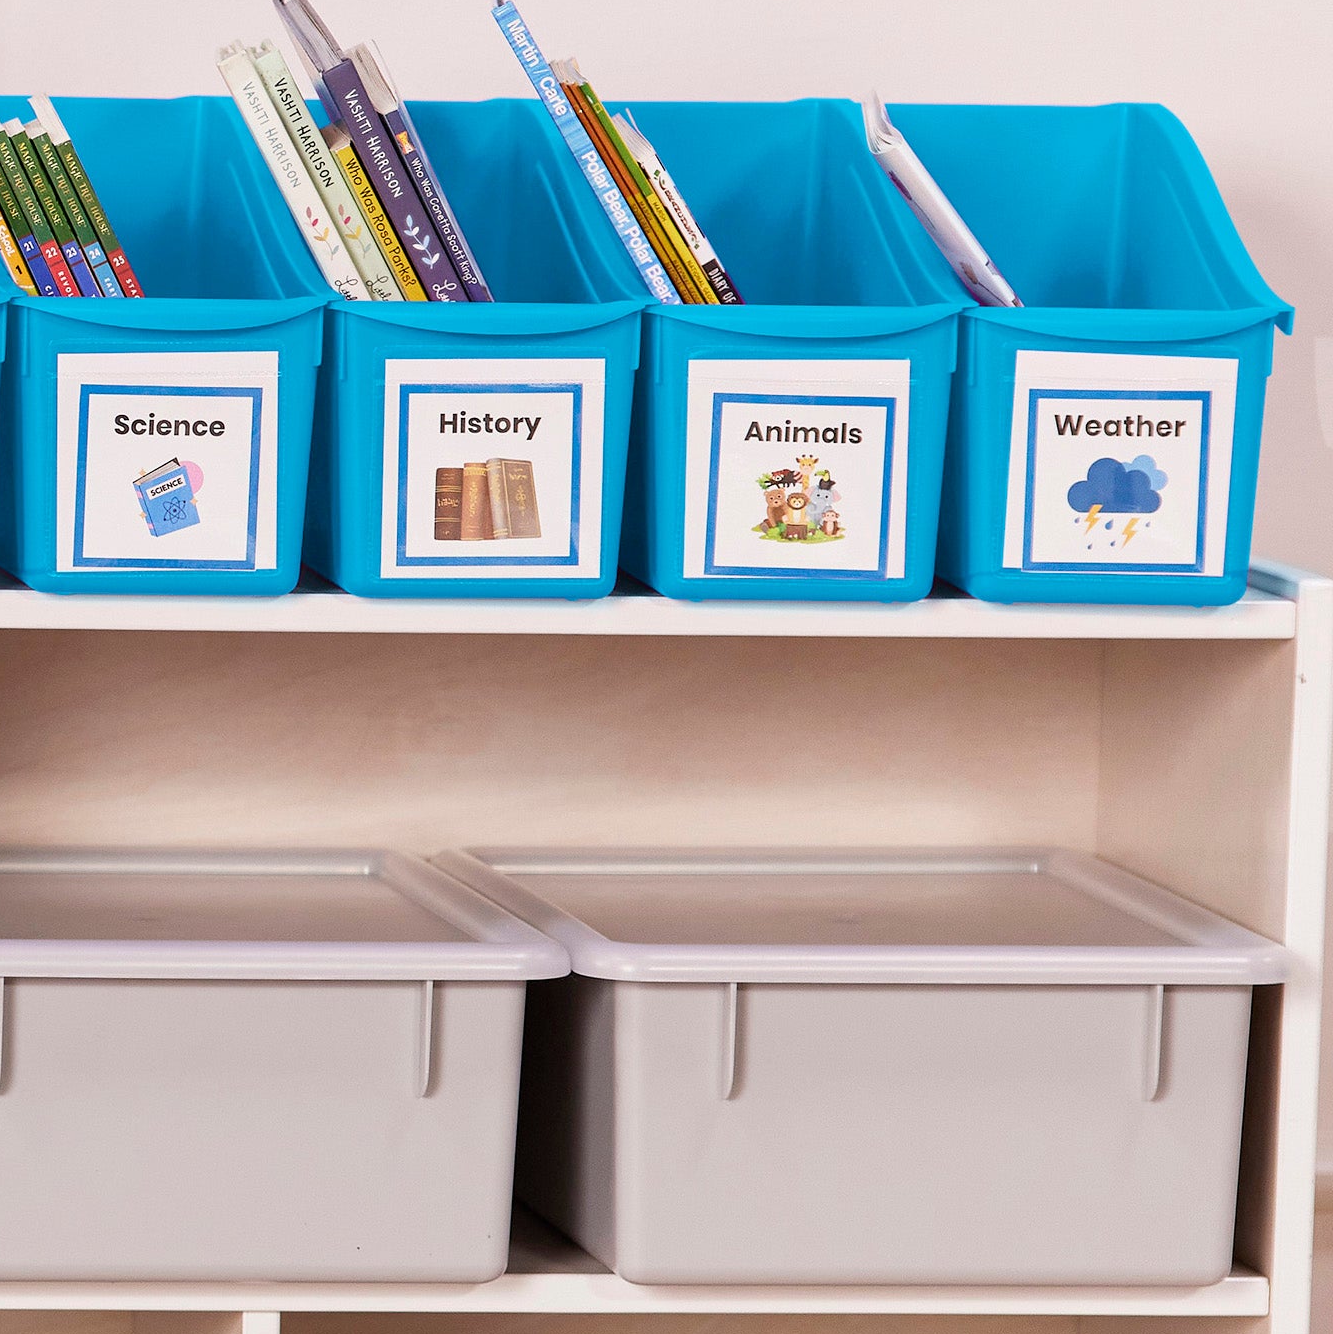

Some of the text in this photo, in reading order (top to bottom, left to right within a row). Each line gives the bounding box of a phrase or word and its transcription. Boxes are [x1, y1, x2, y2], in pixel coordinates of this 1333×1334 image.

[506, 18, 540, 68] Martin
[540, 76, 568, 116] Carle
[242, 81, 301, 189] VASHTI HARRISON
[274, 77, 335, 188] VASHTI HARRISON
[344, 88, 403, 199] VASHTI HARRISON
[18, 142, 61, 226] MAGIC TREE HOUSE
[41, 143, 85, 227] MAGIC TREE HOUSE
[65, 152, 109, 235] MAGIC TREE HOUSE
[1, 189, 19, 219] HOUSE
[13, 173, 27, 194] TREE
[23, 195, 41, 226] HOUSE
[581, 150, 610, 189] Polar
[602, 189, 630, 228] Bear,
[624, 225, 653, 264] Polar
[652, 201, 667, 222] MARSH
[345, 157, 417, 288] Who Was Rosa Parks?
[411, 157, 478, 285] Who Was Coretta Scott King?
[24, 241, 34, 252] 21
[45, 247, 58, 258] 22
[66, 247, 78, 258] 23
[89, 248, 101, 259] 24
[113, 255, 125, 267] 25
[686, 259, 704, 287] NATIONAL
[708, 267, 737, 304] DIARY OF
[114, 413, 226, 437] Science
[440, 411, 542, 440] History
[744, 419, 863, 445] Animals
[1054, 413, 1187, 438] Weather
[150, 477, 183, 497] SCIENCE
